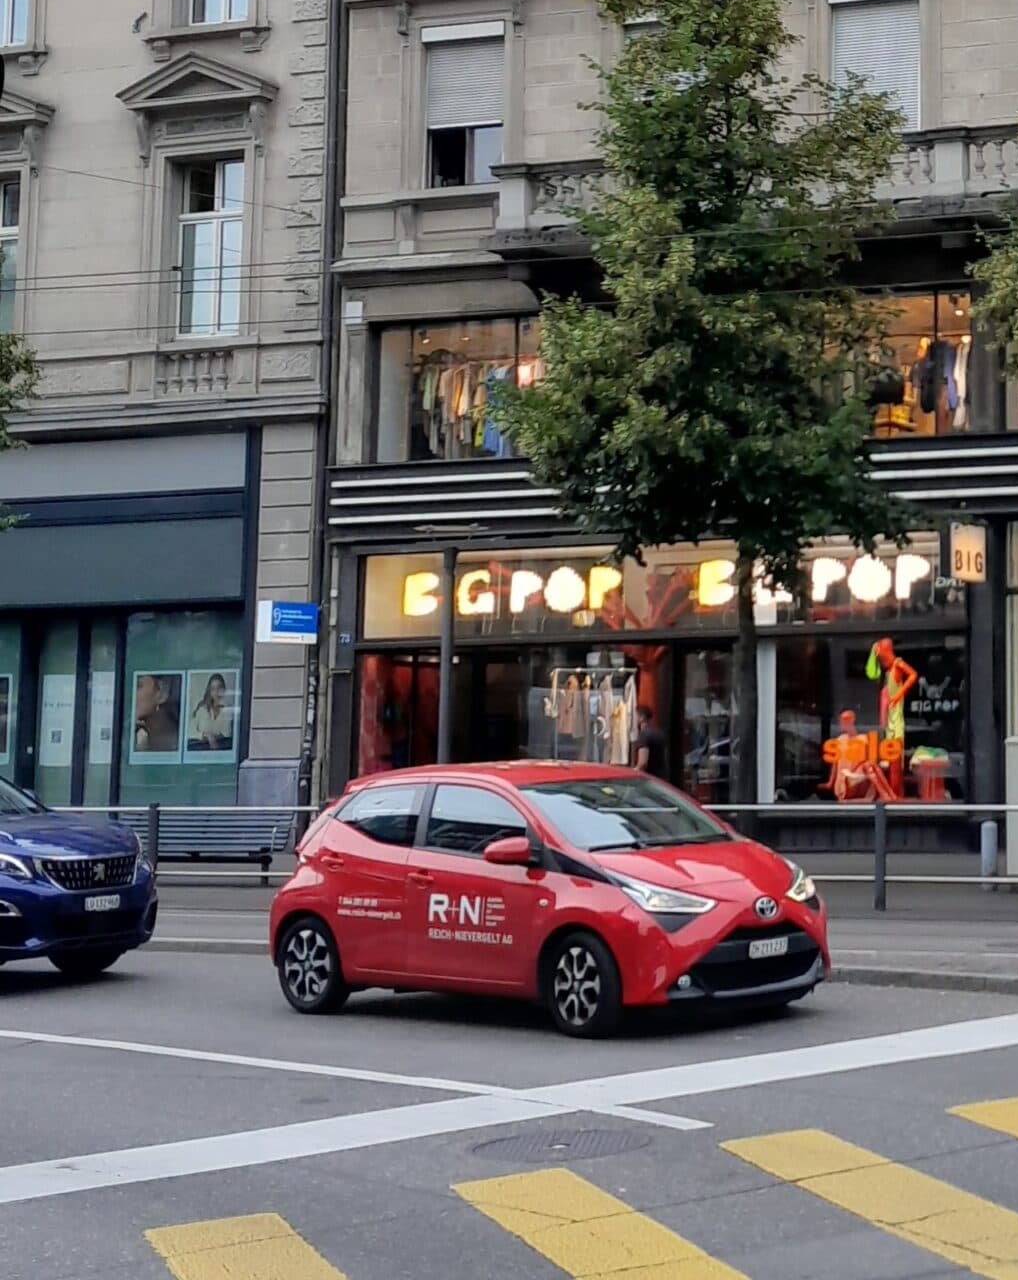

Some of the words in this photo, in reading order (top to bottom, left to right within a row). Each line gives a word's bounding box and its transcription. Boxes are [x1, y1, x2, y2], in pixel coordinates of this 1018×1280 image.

[811, 553, 930, 601] POP
[954, 548, 984, 575] BIG
[403, 570, 495, 616] BG
[509, 565, 622, 613] POP
[934, 700, 960, 712] POP
[822, 730, 902, 764] sale
